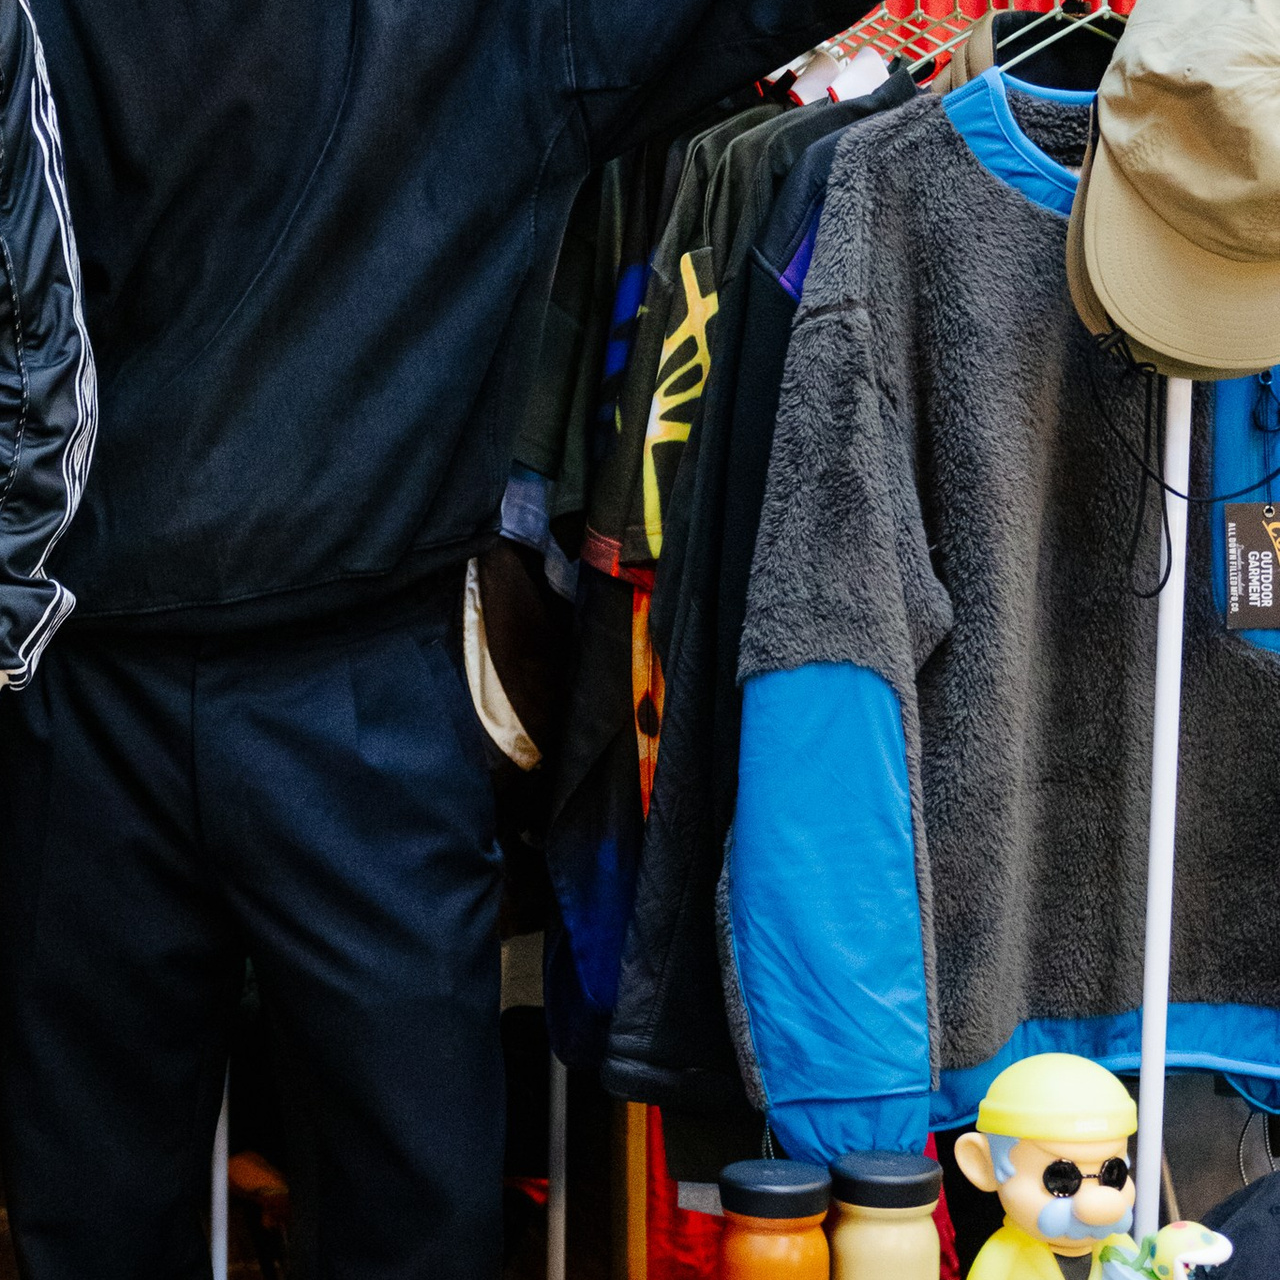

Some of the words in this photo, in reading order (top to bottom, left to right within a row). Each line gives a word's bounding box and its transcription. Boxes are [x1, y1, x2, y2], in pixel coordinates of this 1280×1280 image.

[1228, 522, 1236, 537] ALL
[1228, 537, 1237, 560] DOWN
[1229, 561, 1238, 586] FILLED
[1248, 550, 1260, 608] GARMENT
[1260, 550, 1273, 607] OUTDOOR
